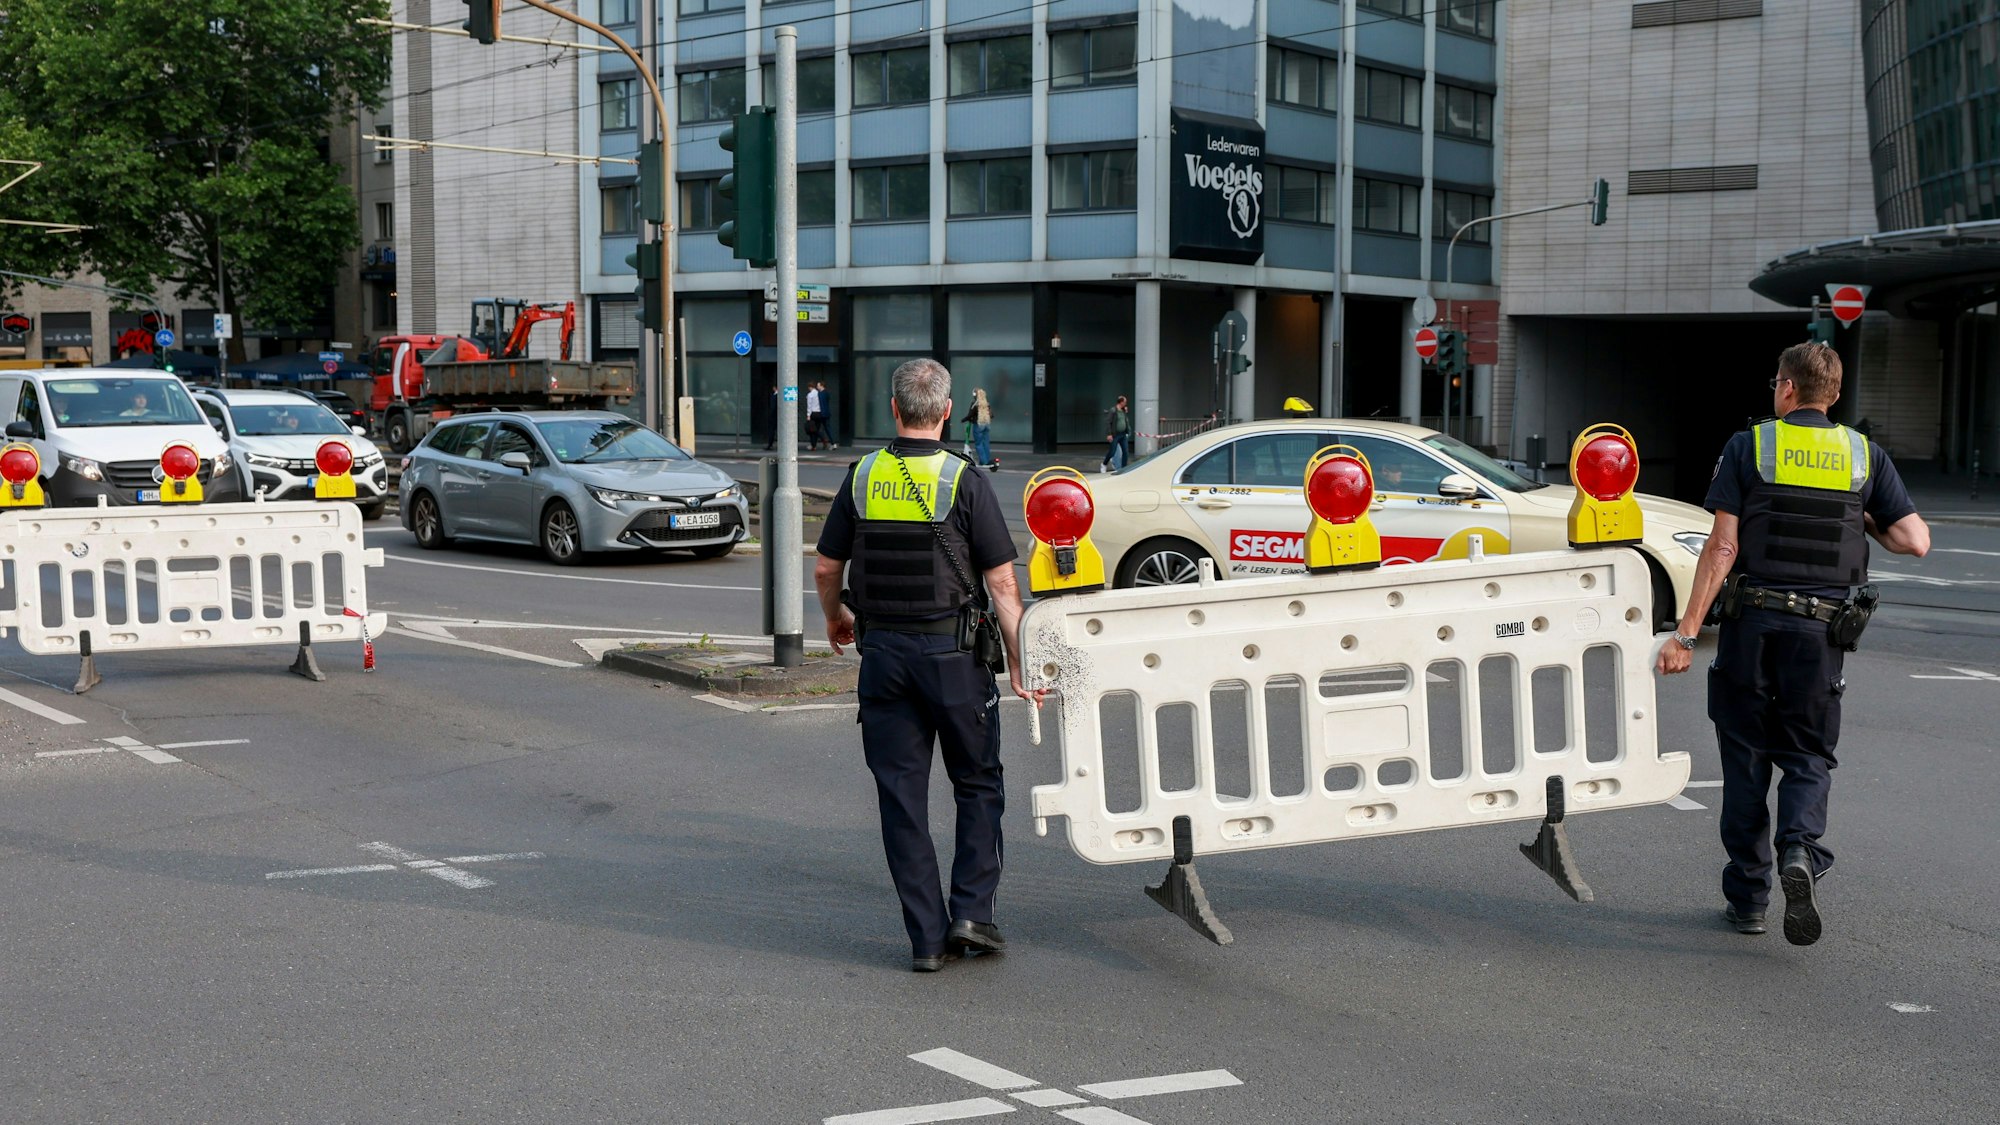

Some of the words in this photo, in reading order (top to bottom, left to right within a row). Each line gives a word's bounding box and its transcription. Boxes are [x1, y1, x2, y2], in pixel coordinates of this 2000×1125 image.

[1207, 133, 1260, 157] Lederwaren
[1184, 153, 1263, 200] Voegels
[1783, 448, 1845, 471] POLIZEI
[143, 491, 154, 500] HH
[872, 480, 931, 502] POLIZEI
[1229, 487, 1252, 495] 2882
[676, 516, 682, 526] K
[686, 515, 698, 525] EA
[699, 514, 719, 524] 1058
[1232, 534, 1304, 559] SEGM
[1495, 621, 1525, 636] COMBO
